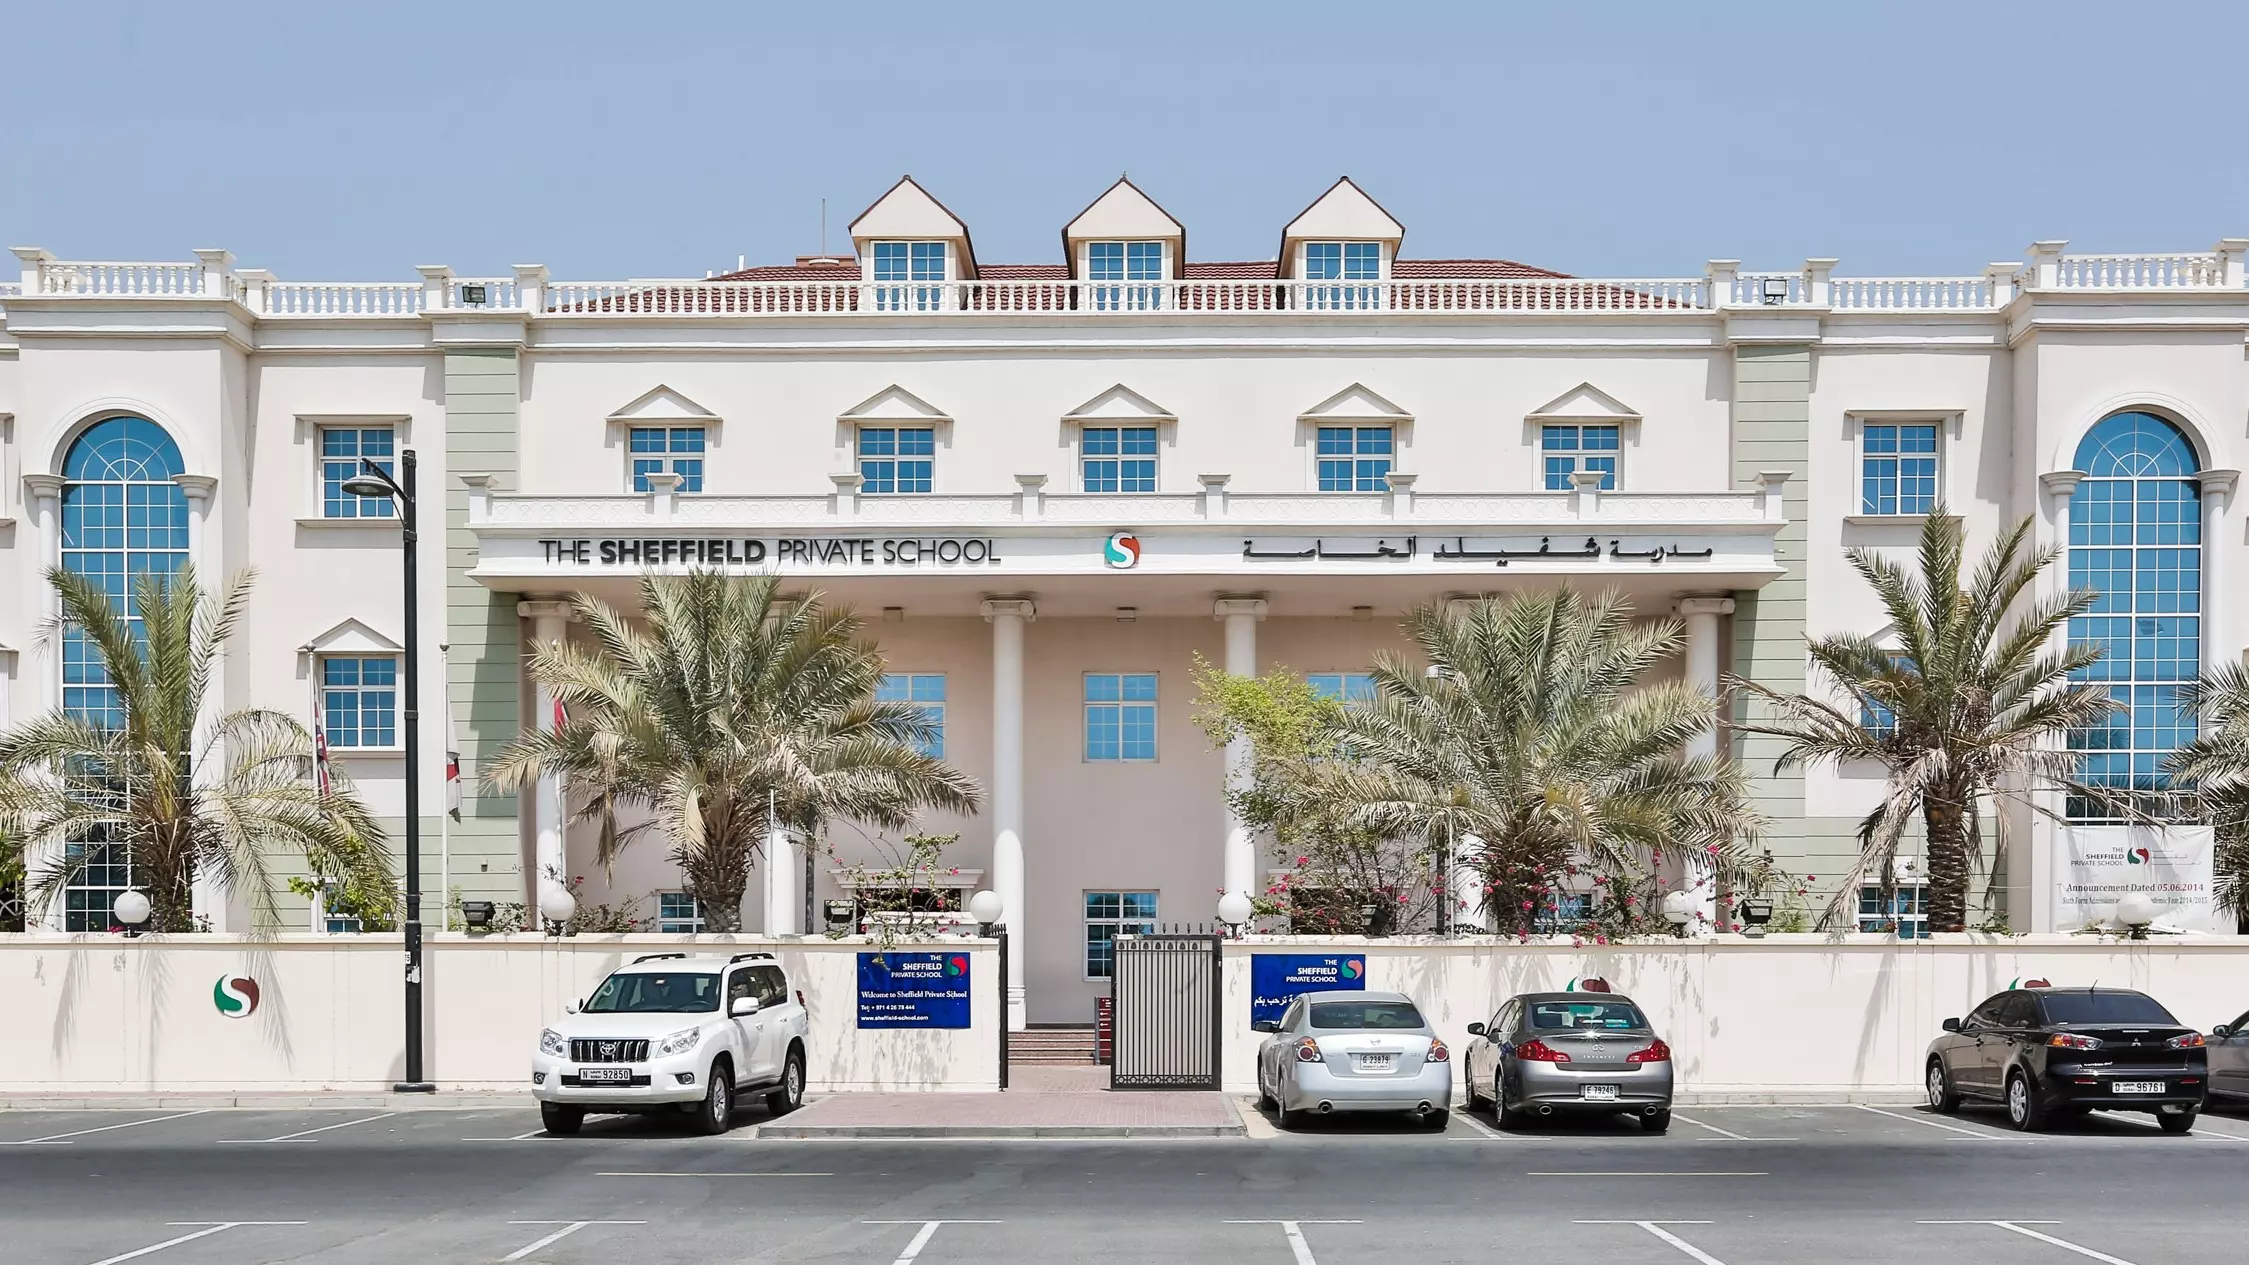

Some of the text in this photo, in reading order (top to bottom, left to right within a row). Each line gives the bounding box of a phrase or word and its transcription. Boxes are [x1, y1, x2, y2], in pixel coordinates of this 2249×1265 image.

[539, 539, 1002, 564] THE SHEFFIELD PRIVATE SCHOOL
[1243, 535, 1713, 567] مدرسة شفيلد الخاصة
[2066, 884, 2204, 892] Announcement Dated 05.06.2014
[603, 1070, 628, 1079] 92850
[2137, 1083, 2162, 1091] 96761
